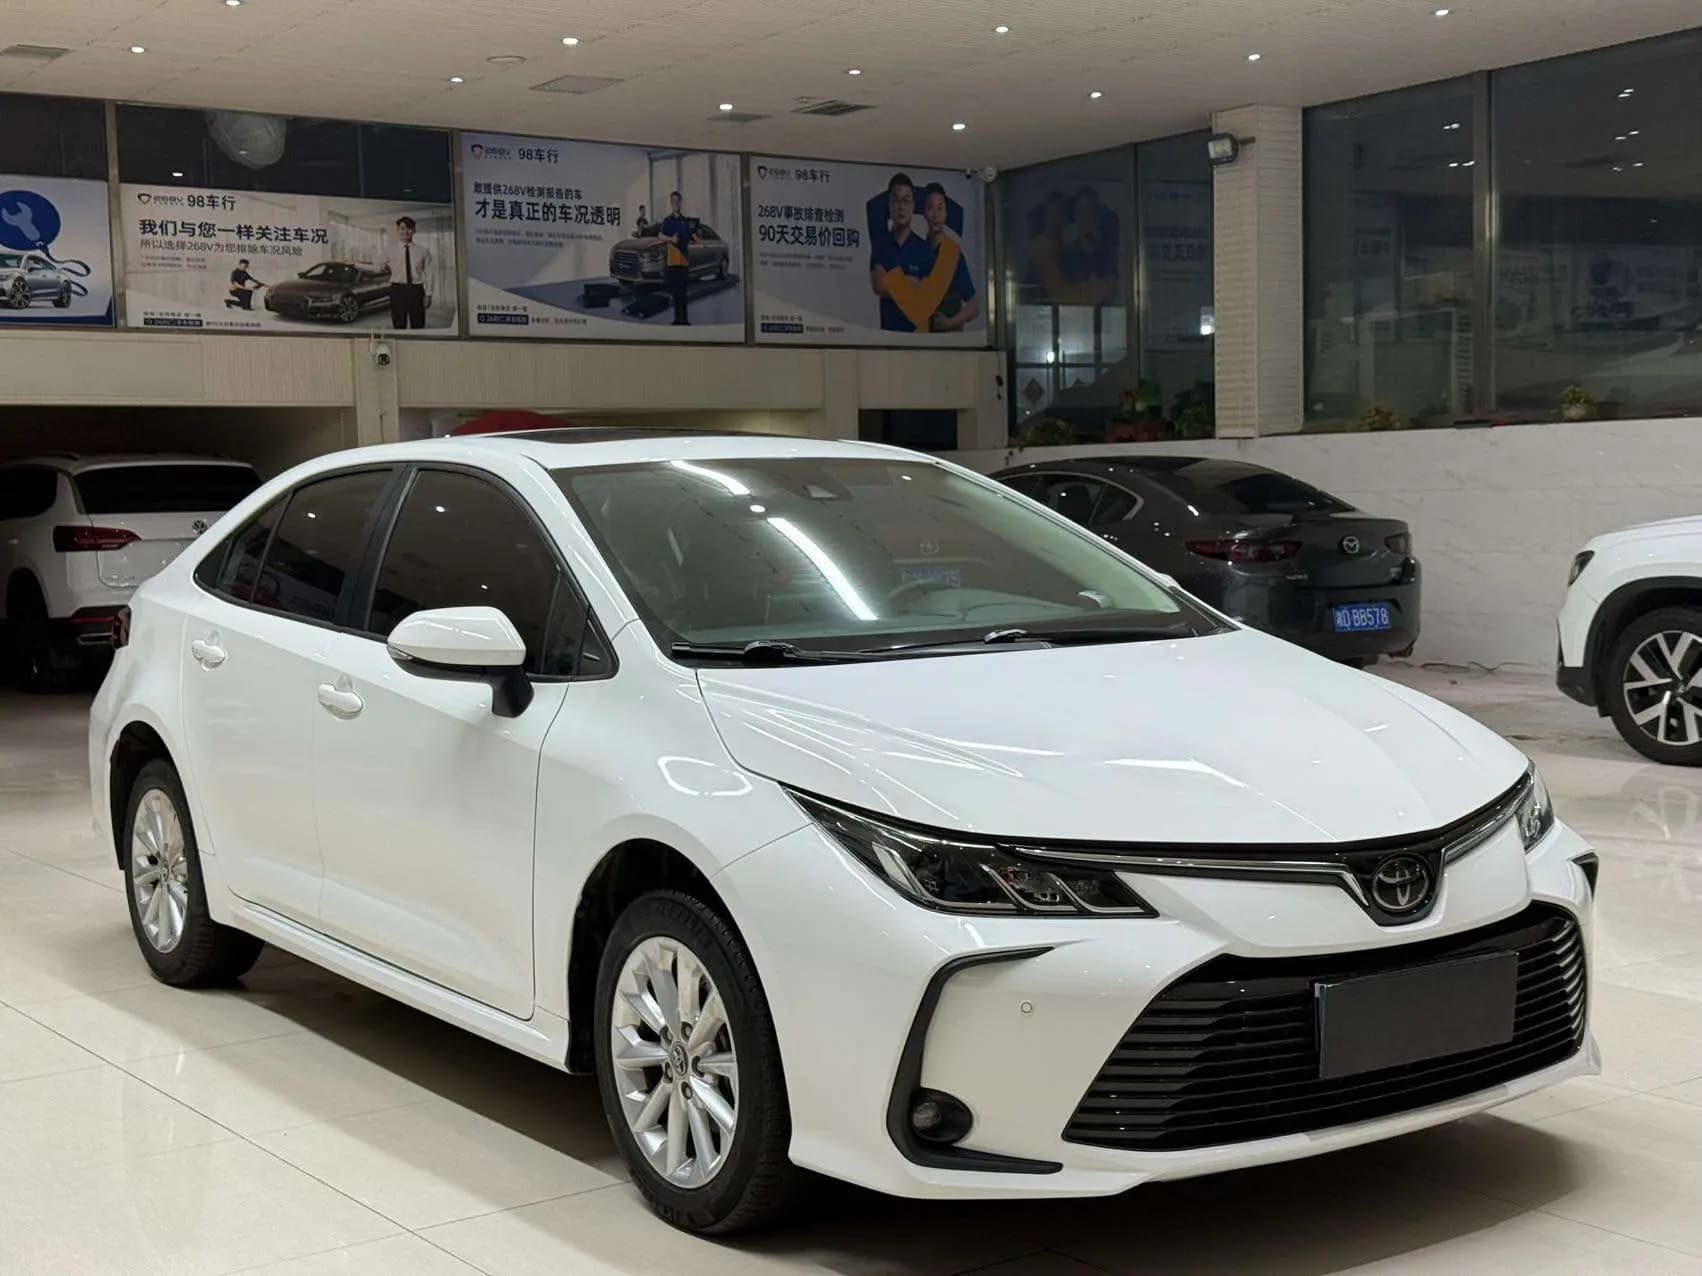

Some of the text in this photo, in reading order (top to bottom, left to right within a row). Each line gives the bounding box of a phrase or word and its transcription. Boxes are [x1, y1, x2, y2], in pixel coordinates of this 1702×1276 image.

[518, 148, 559, 164] 98车行
[795, 169, 831, 183] 98车行
[187, 194, 236, 211] 98车行
[475, 198, 621, 227] 才是真正的车况透明
[758, 204, 845, 223] 268V事故排查检测
[139, 219, 329, 244] 我们与您一样关注车况
[759, 225, 860, 248] 90天交易价回购
[140, 238, 304, 257] 所以选择268V为您排除车况风险
